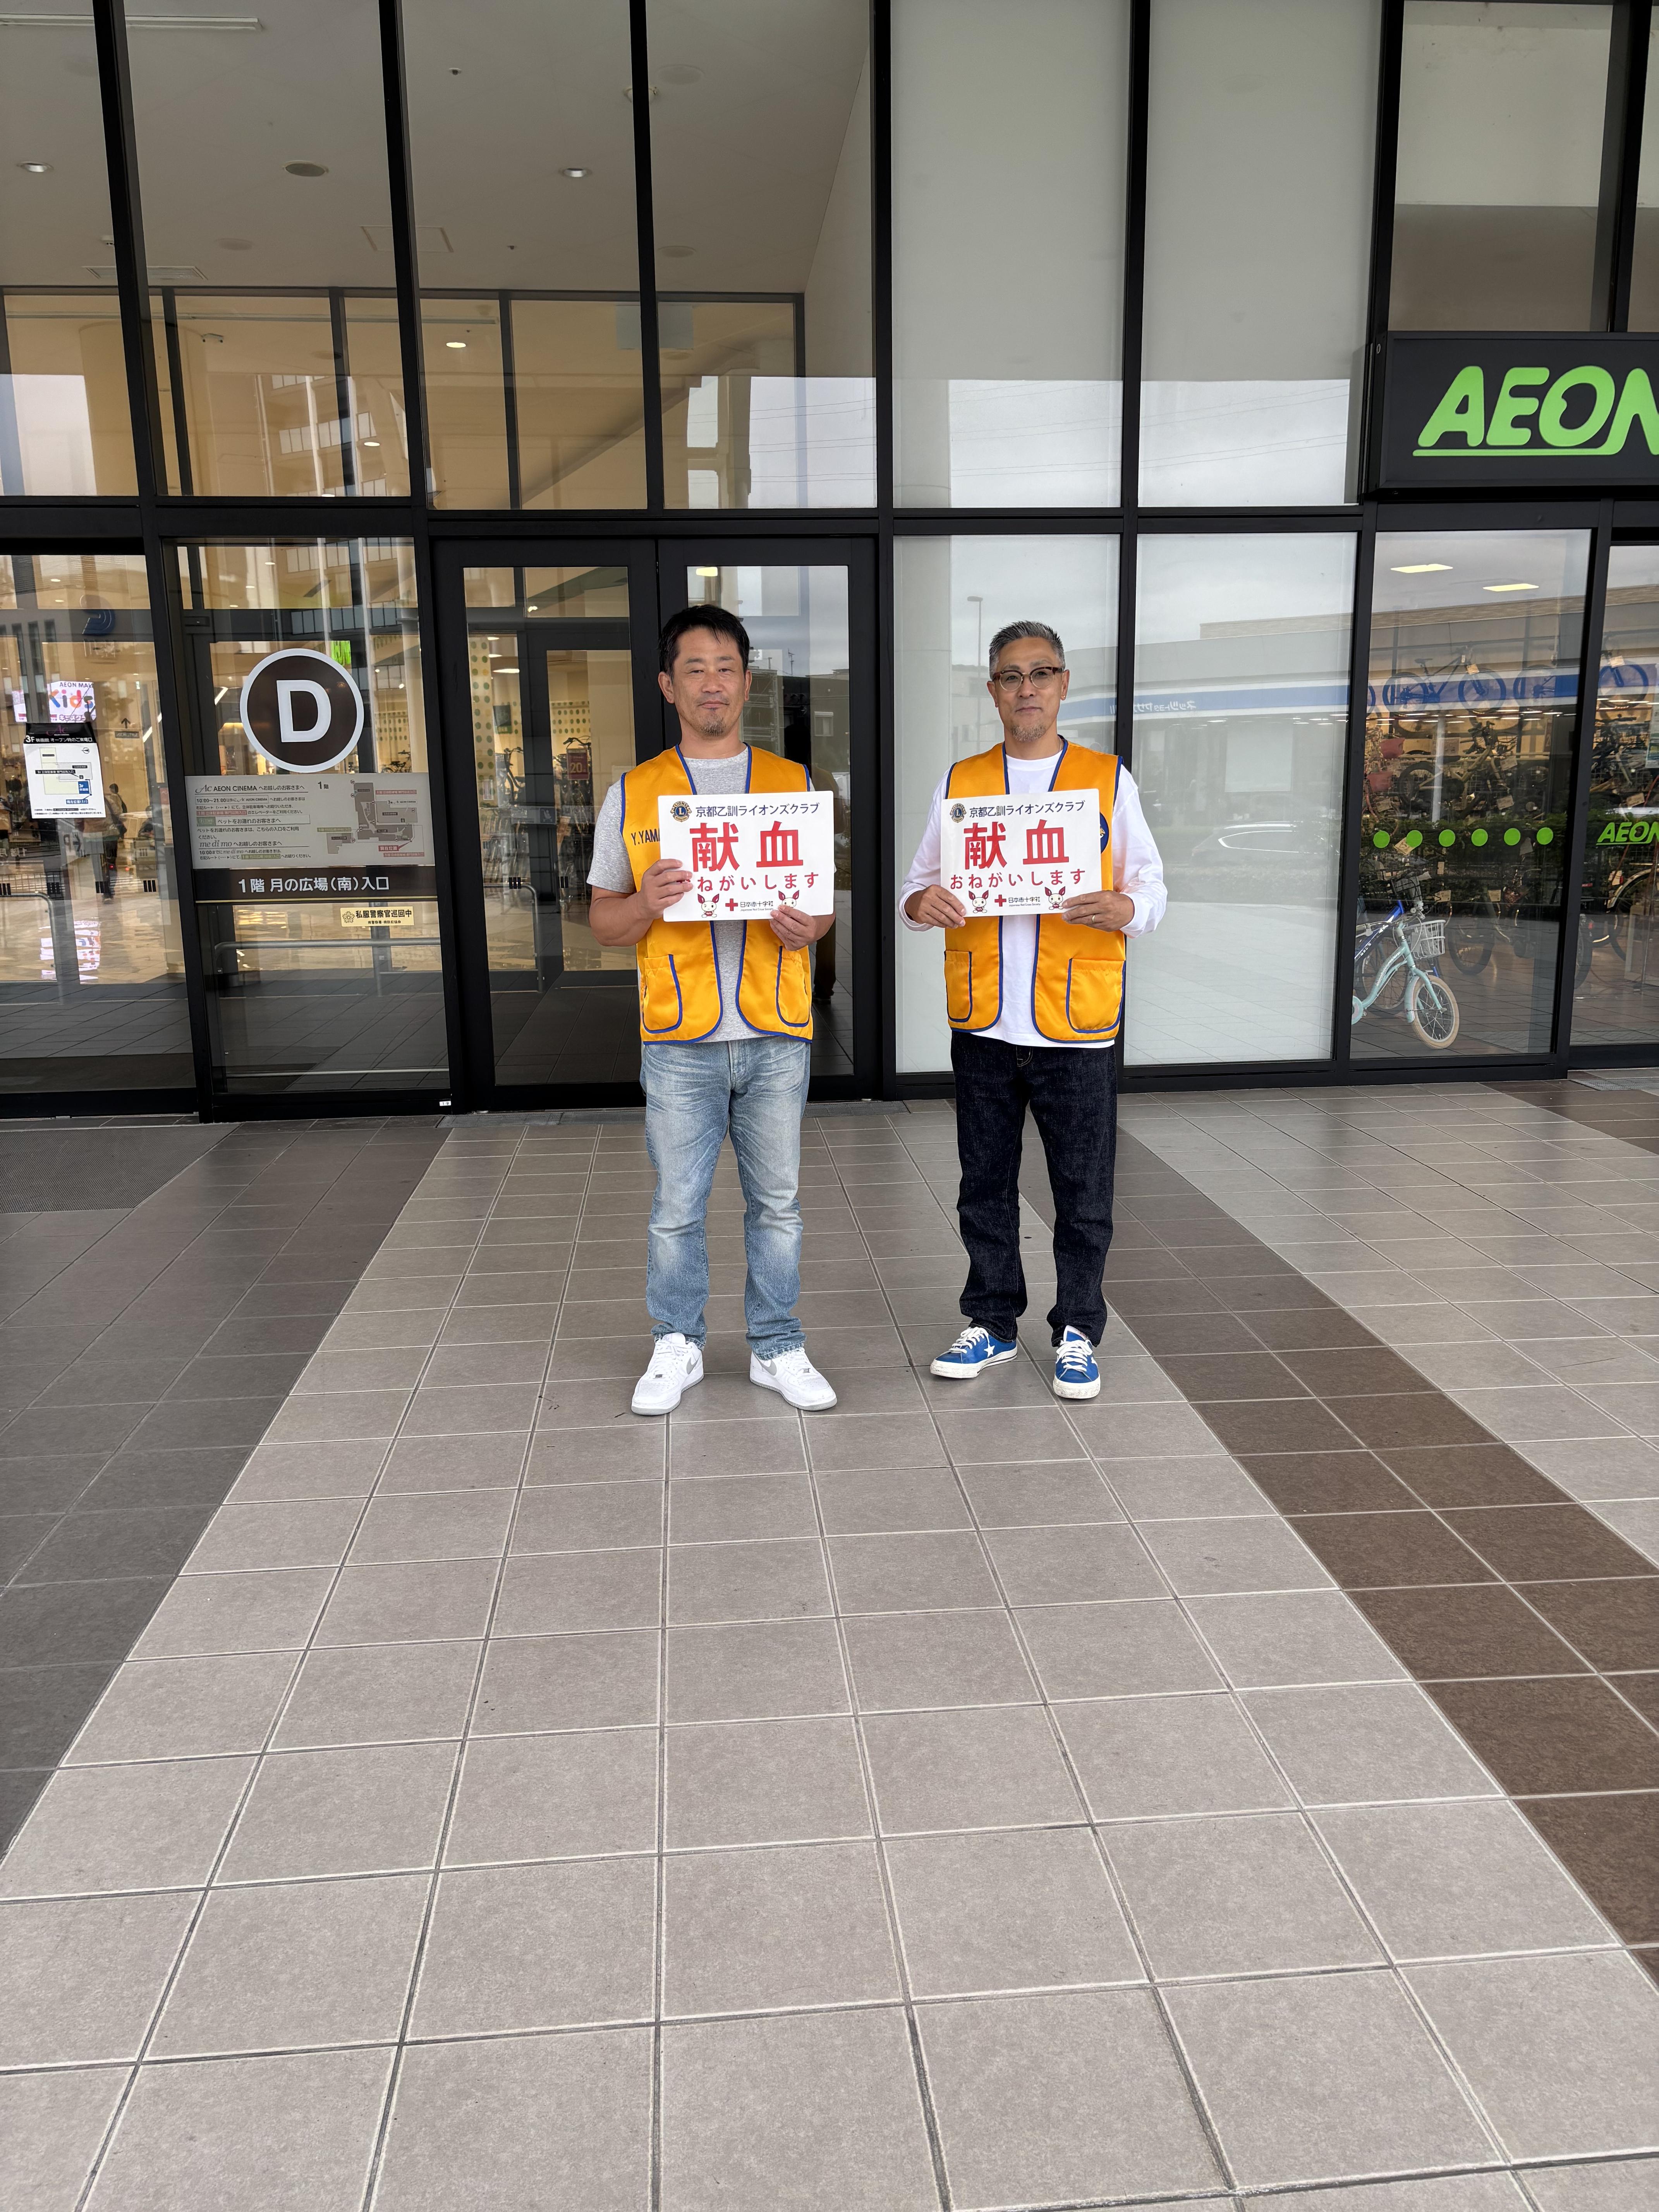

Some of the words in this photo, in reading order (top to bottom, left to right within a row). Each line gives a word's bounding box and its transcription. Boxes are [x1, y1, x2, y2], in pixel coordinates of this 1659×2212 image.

[1413, 366, 1659, 456] AEON
[49, 689, 93, 708] Kids
[276, 680, 331, 742] D
[696, 802, 819, 817] 京都乙訓ライオンズクラブ
[969, 800, 1085, 818] 京都乙訓ライオンズクラブ
[1595, 821, 1659, 845] AEON
[690, 821, 804, 872] 献血
[963, 819, 1069, 870] 献血
[239, 878, 265, 893] 1階
[270, 877, 390, 892] 月の広場（南）入口
[677, 871, 819, 892] ねがいします
[950, 869, 1085, 890] おねがいします
[356, 909, 412, 919] 私服警察官巡回中
